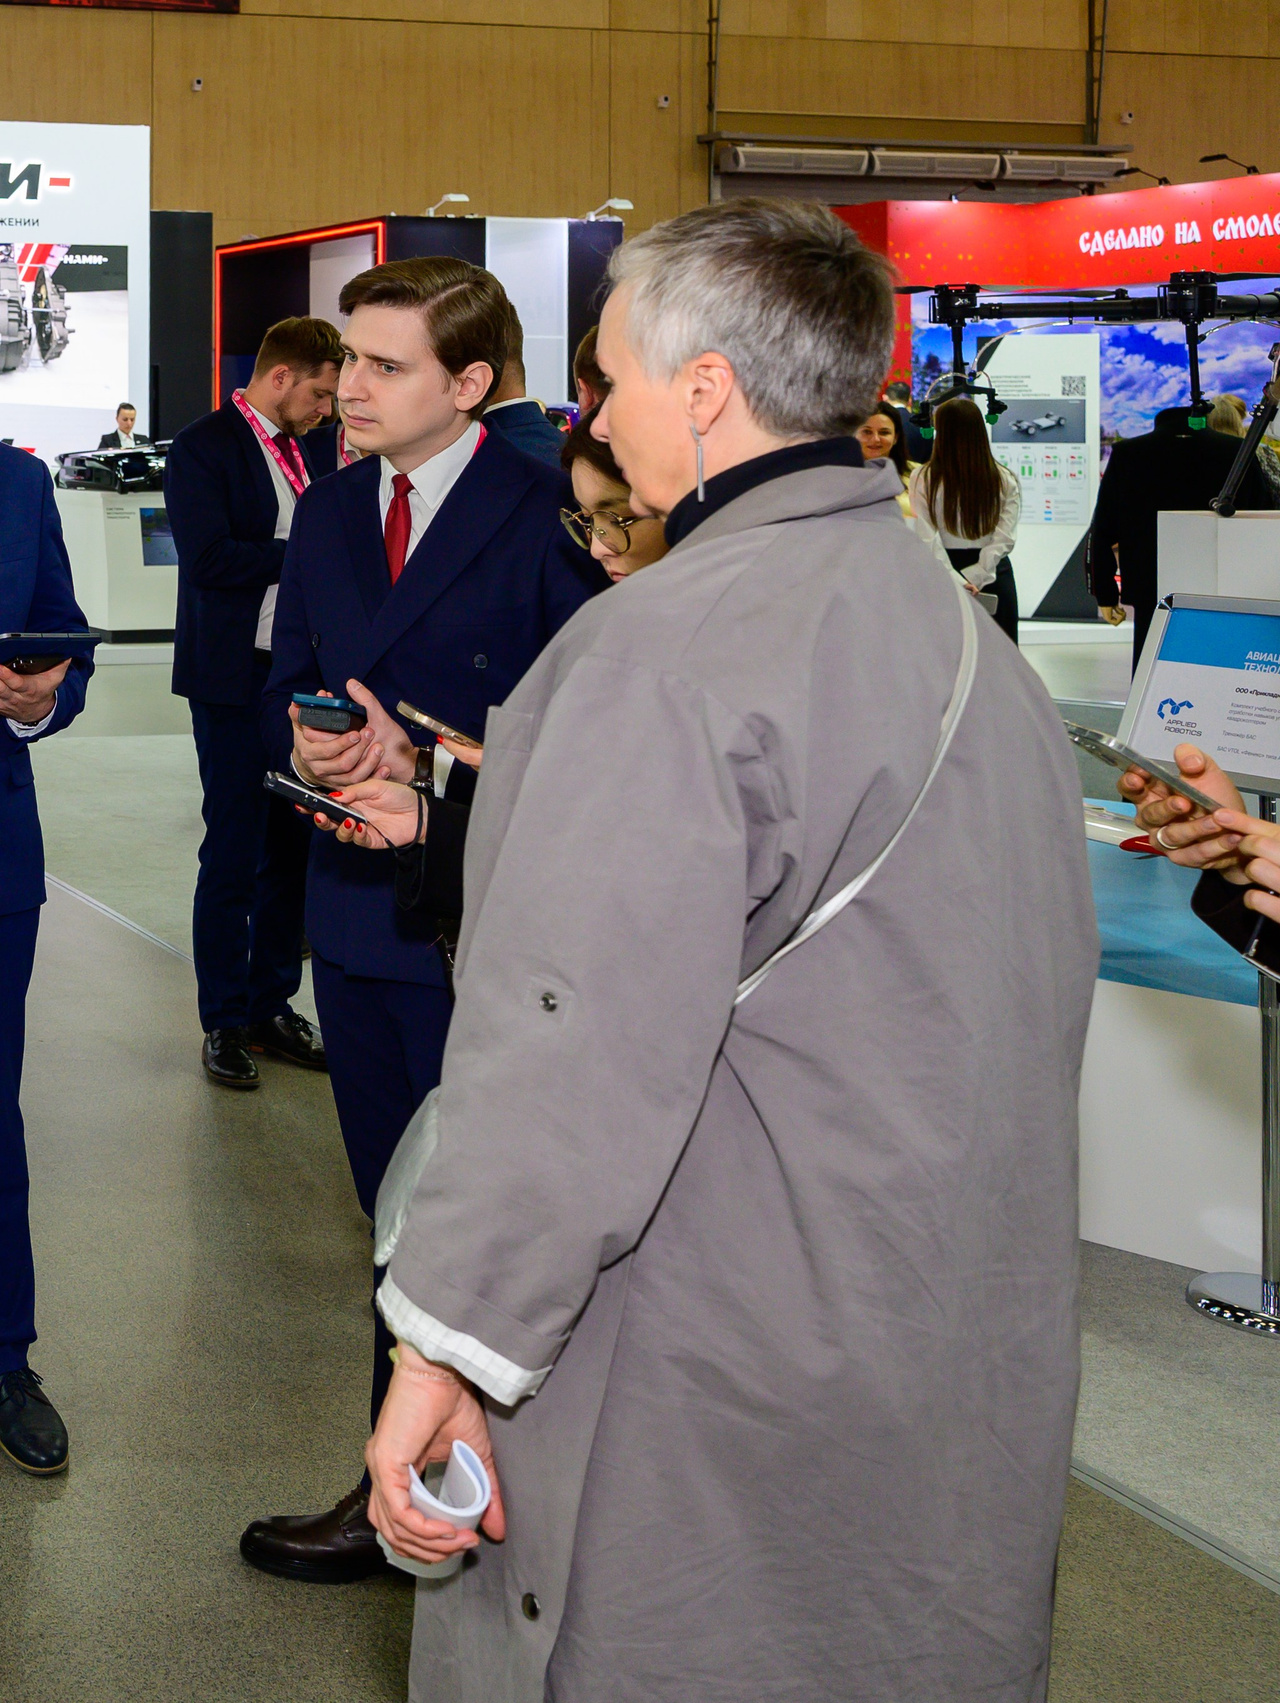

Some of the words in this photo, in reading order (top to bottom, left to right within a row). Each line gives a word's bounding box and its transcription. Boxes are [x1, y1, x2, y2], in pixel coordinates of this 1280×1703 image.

[1078, 224, 1165, 257] СДЕЛАНО
[1174, 220, 1202, 245] НА
[1167, 719, 1197, 728] APPLIED
[1164, 726, 1202, 737] ROBOTICS
